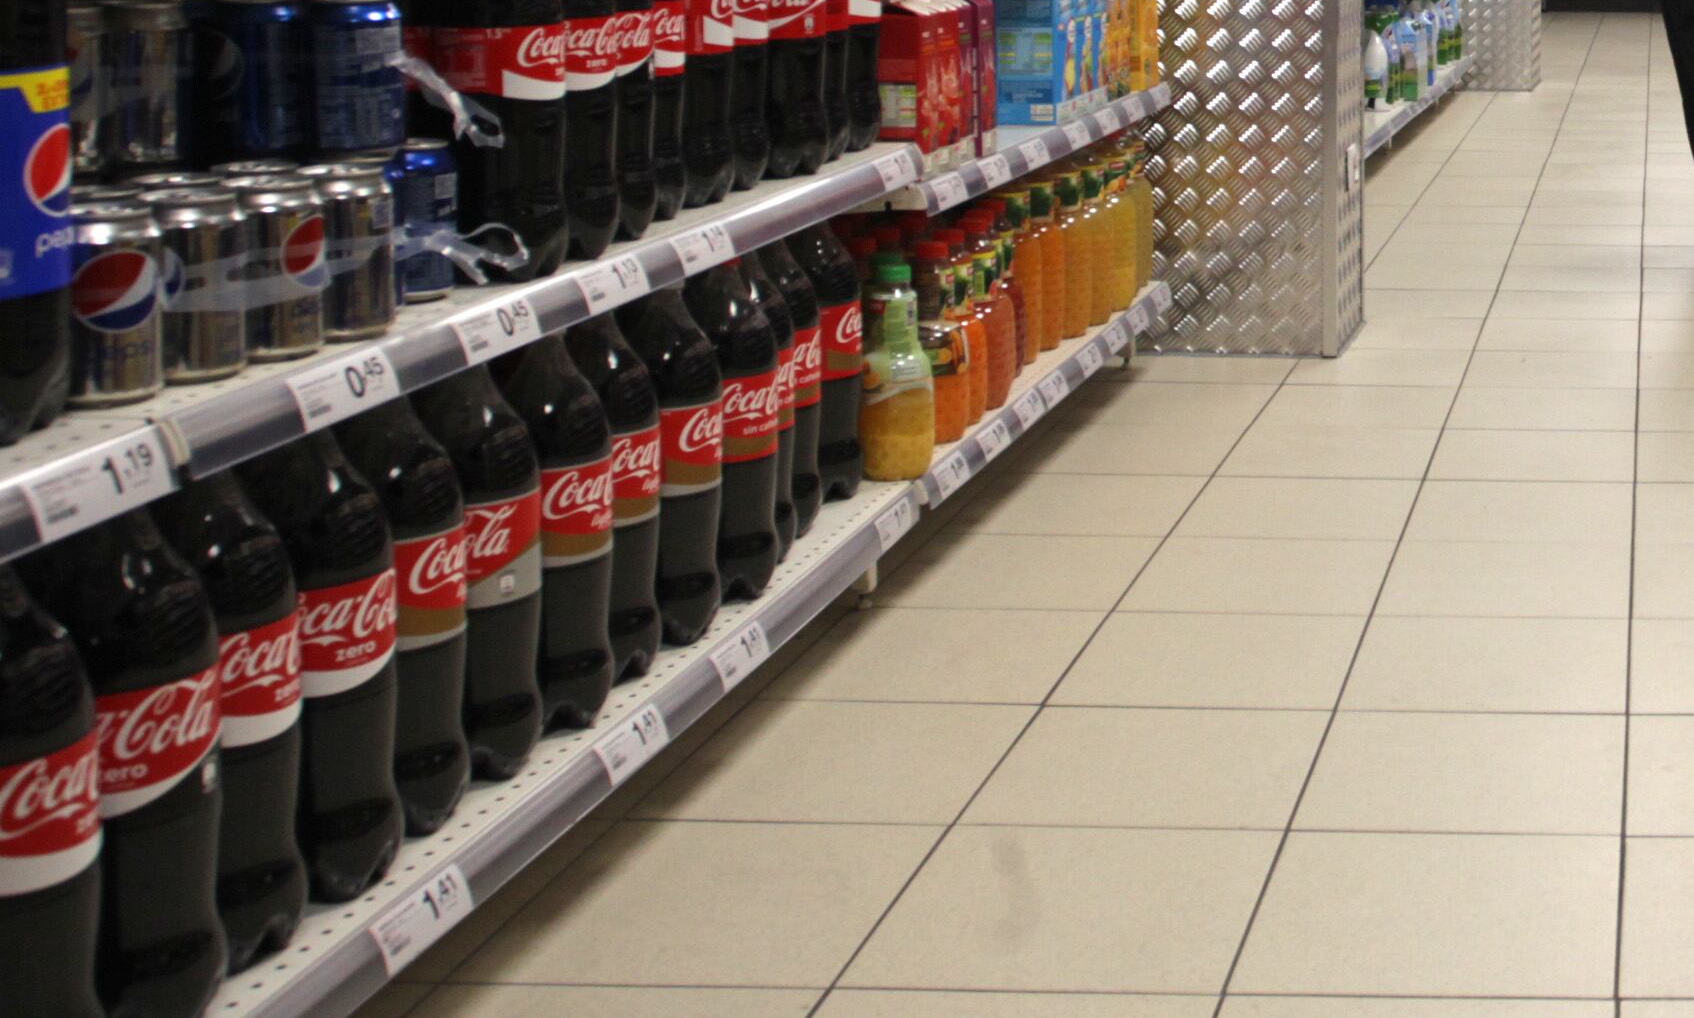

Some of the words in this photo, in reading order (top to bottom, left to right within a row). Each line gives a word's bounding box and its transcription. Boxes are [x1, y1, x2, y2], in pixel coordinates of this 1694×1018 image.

[517, 27, 564, 68] Coca
[542, 471, 612, 520] Coca
[336, 640, 376, 662] zero
[103, 763, 148, 782] ero
